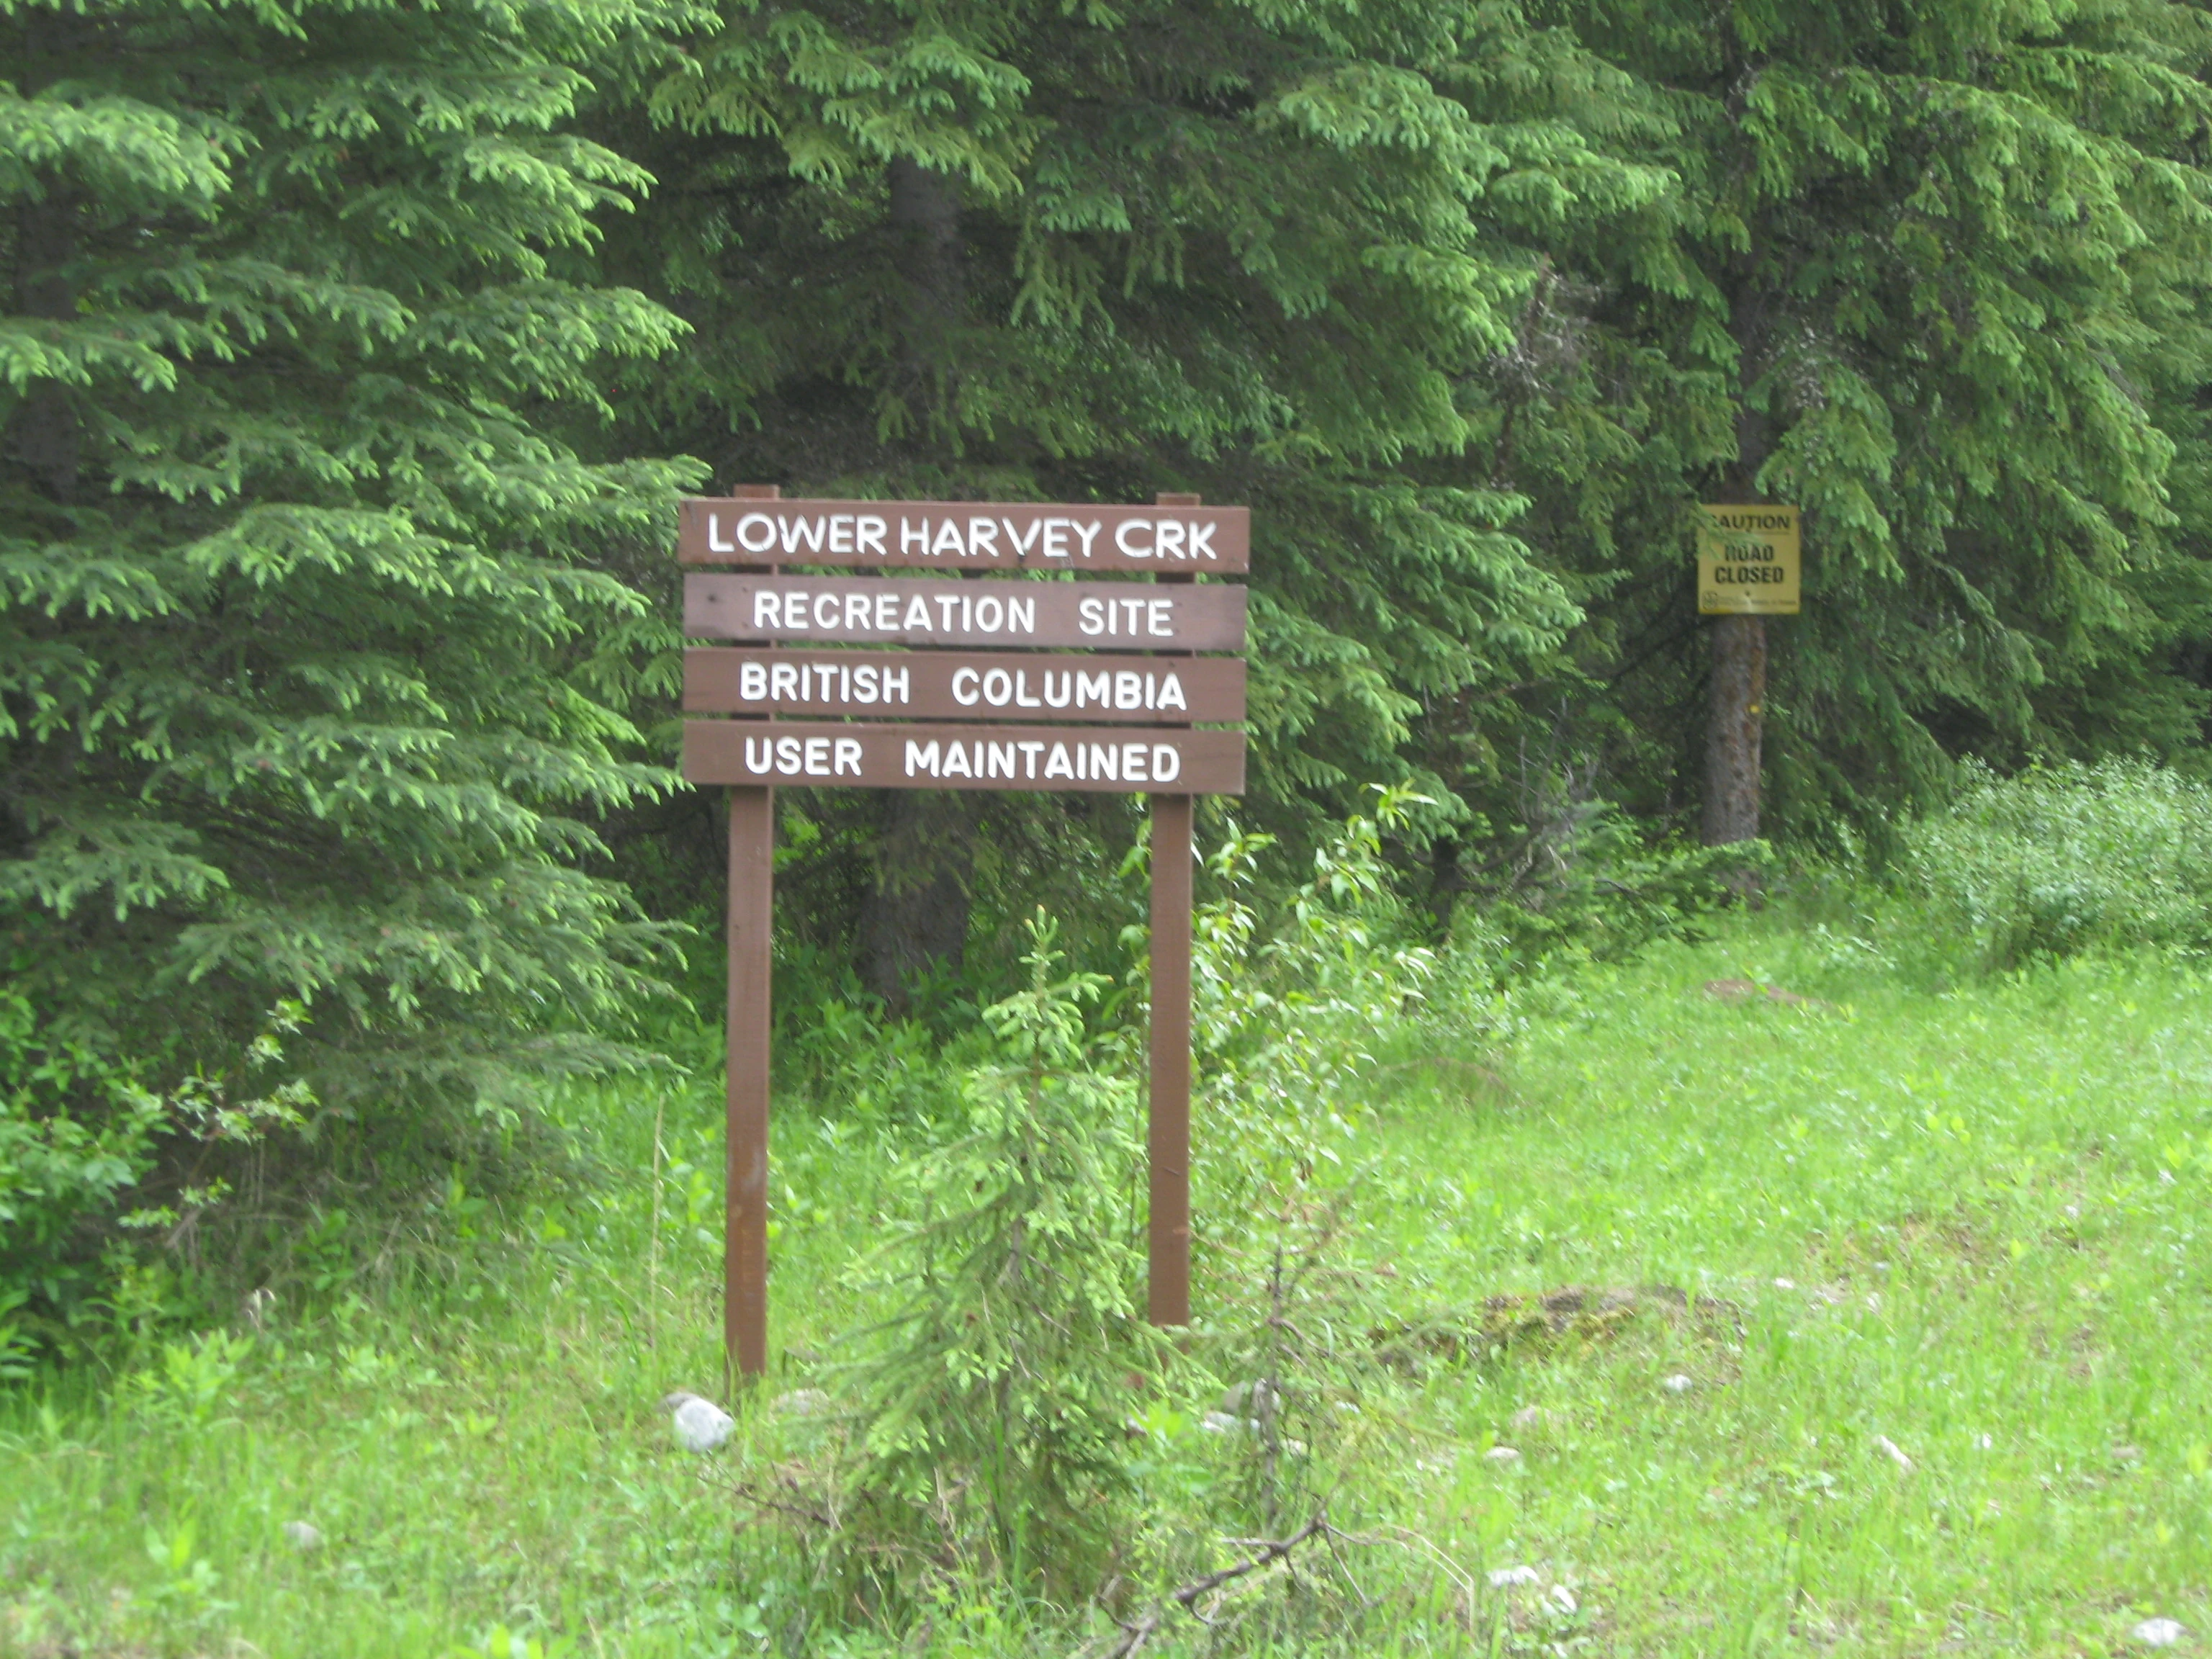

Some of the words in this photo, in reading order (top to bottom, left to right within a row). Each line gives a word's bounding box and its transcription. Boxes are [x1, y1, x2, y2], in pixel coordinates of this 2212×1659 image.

[709, 512, 887, 555] LOWER
[901, 516, 1102, 558] HARVEY
[1115, 518, 1217, 559] CRK
[1714, 566, 1784, 584] CLOSED
[753, 590, 1035, 634] RECREATION
[1079, 597, 1174, 637] SITE
[739, 661, 909, 704] BRITISH
[951, 666, 1187, 711] COLUMBIA
[745, 735, 863, 777] USER
[904, 739, 1181, 783] MAINTAINED
